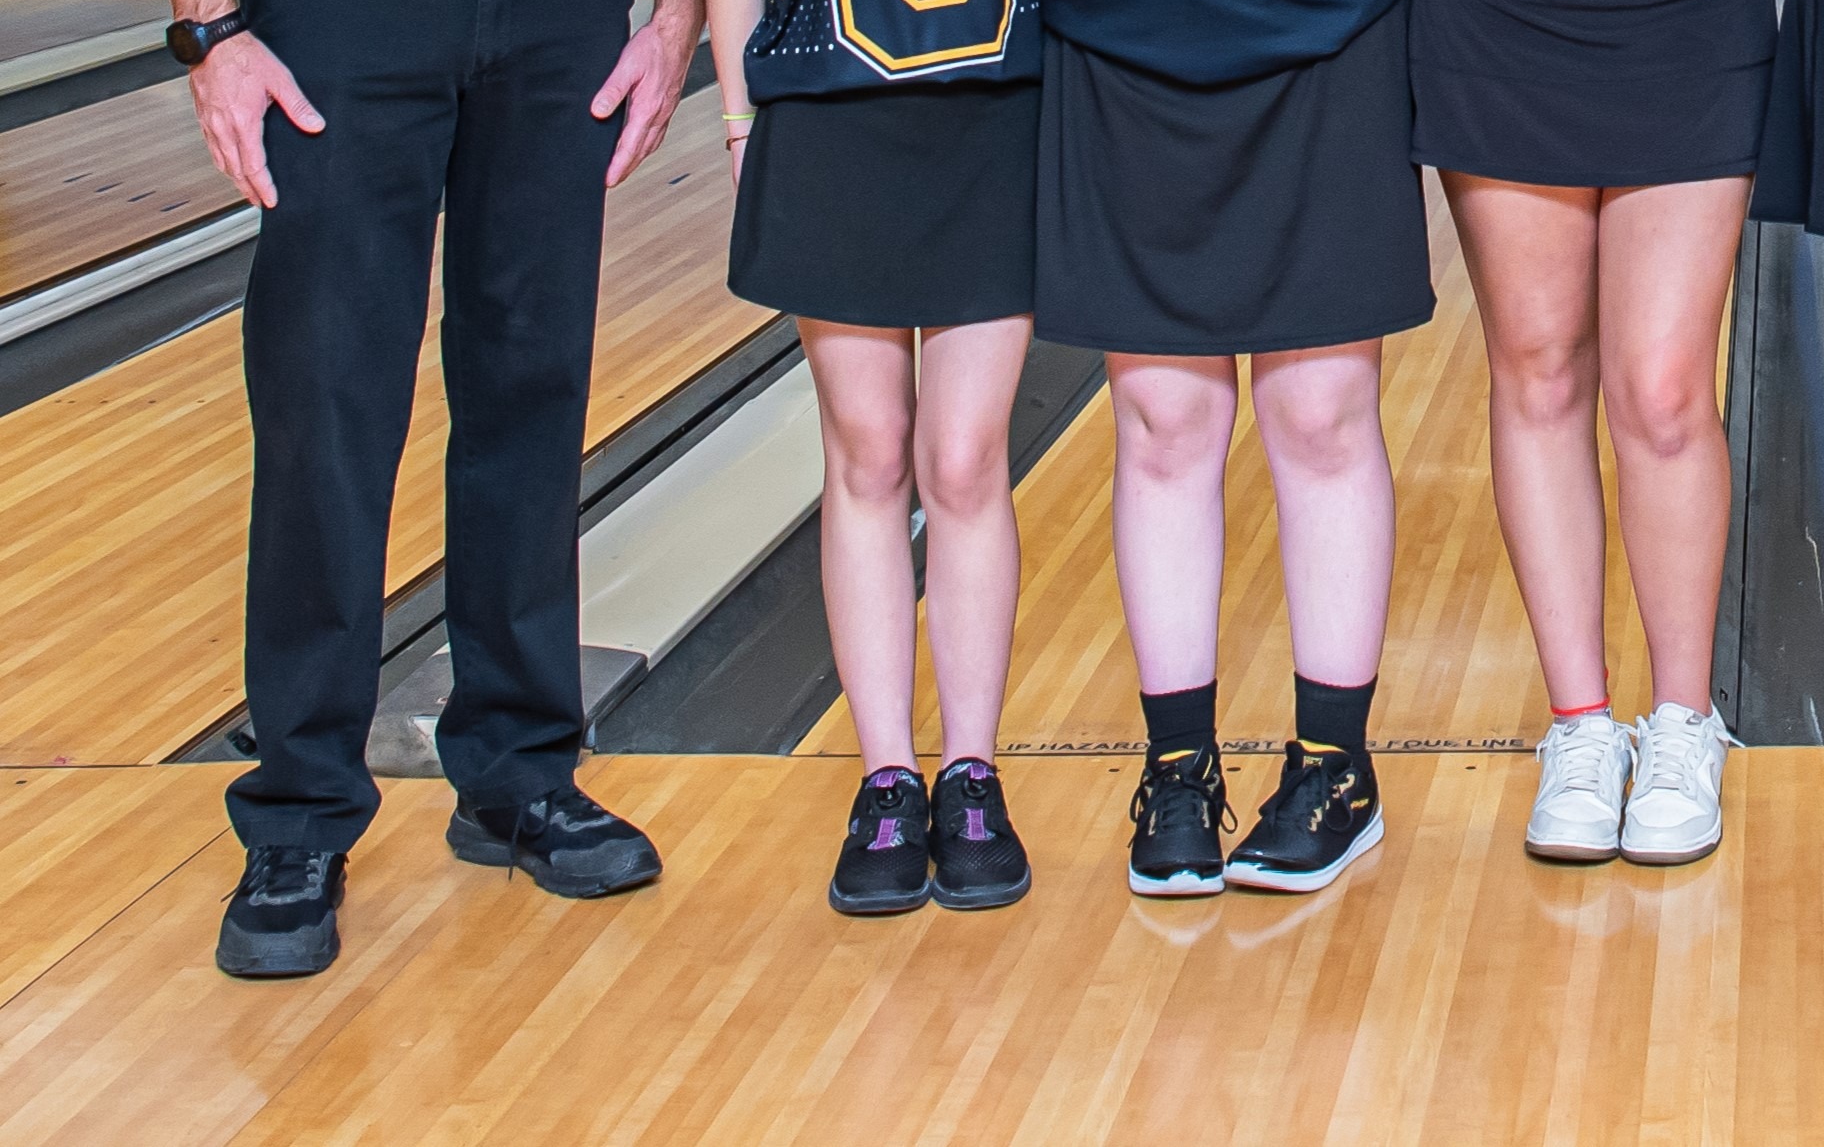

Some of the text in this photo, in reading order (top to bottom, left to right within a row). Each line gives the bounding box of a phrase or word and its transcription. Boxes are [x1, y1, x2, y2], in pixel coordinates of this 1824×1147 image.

[1039, 741, 1150, 751] HAZARD
[1221, 740, 1276, 750] NOT
[1466, 738, 1526, 749] LINE
